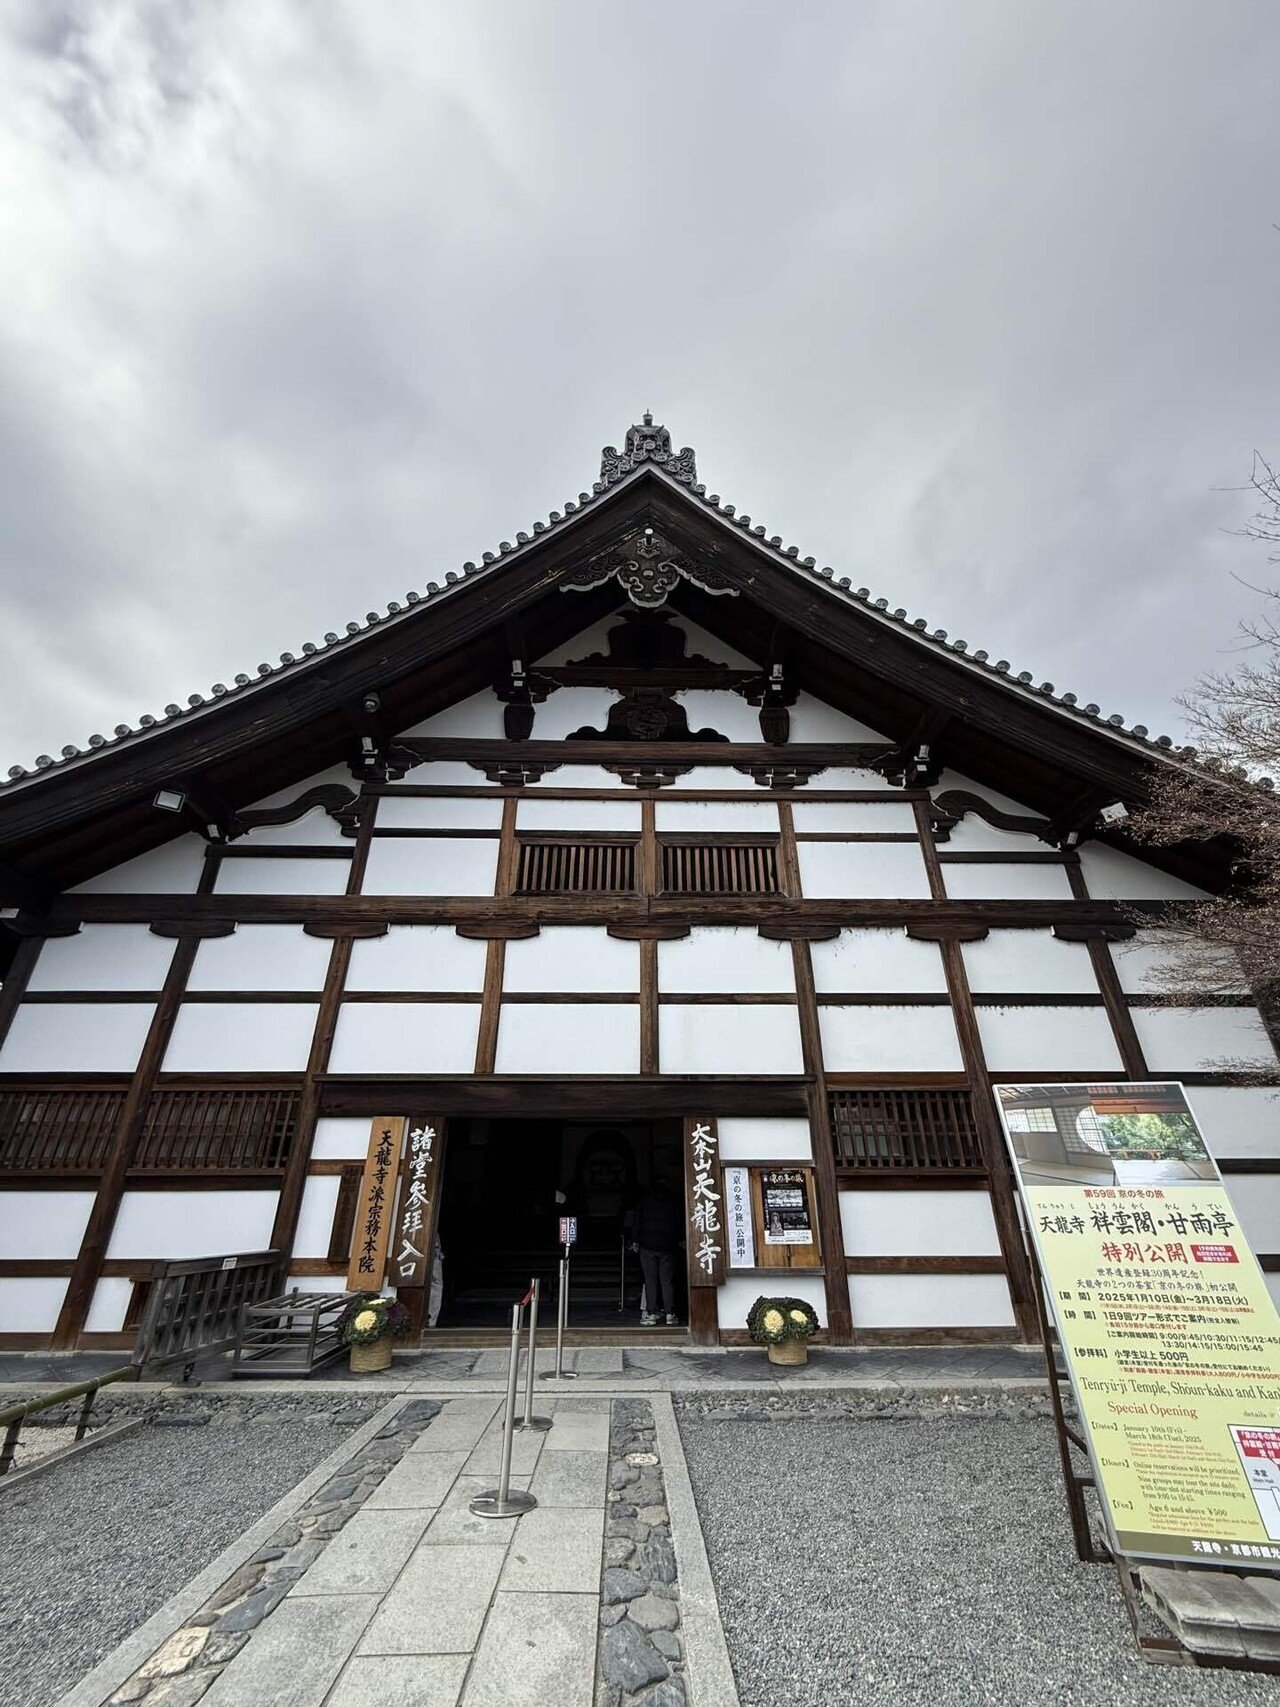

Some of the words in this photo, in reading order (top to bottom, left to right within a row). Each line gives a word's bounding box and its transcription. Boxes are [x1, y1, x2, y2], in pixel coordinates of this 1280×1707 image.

[358, 1130, 394, 1273] 天龍寺派宗務本院
[1084, 1189, 1115, 1198] 第59回
[1119, 1190, 1164, 1199] 京の冬の旅
[1040, 1215, 1085, 1234] 天龍寺
[1090, 1210, 1234, 1237] 祥雲閣・甘雨亭
[1101, 1242, 1188, 1264] 特別公開
[1162, 1341, 1263, 1351] 13:30/14:15/15:00/15:45
[1160, 1352, 1189, 1361] 500円
[1129, 1380, 1170, 1395] Temple,
[1236, 1386, 1256, 1398] and
[1108, 1401, 1148, 1414] Special
[1150, 1403, 1198, 1419] Opening
